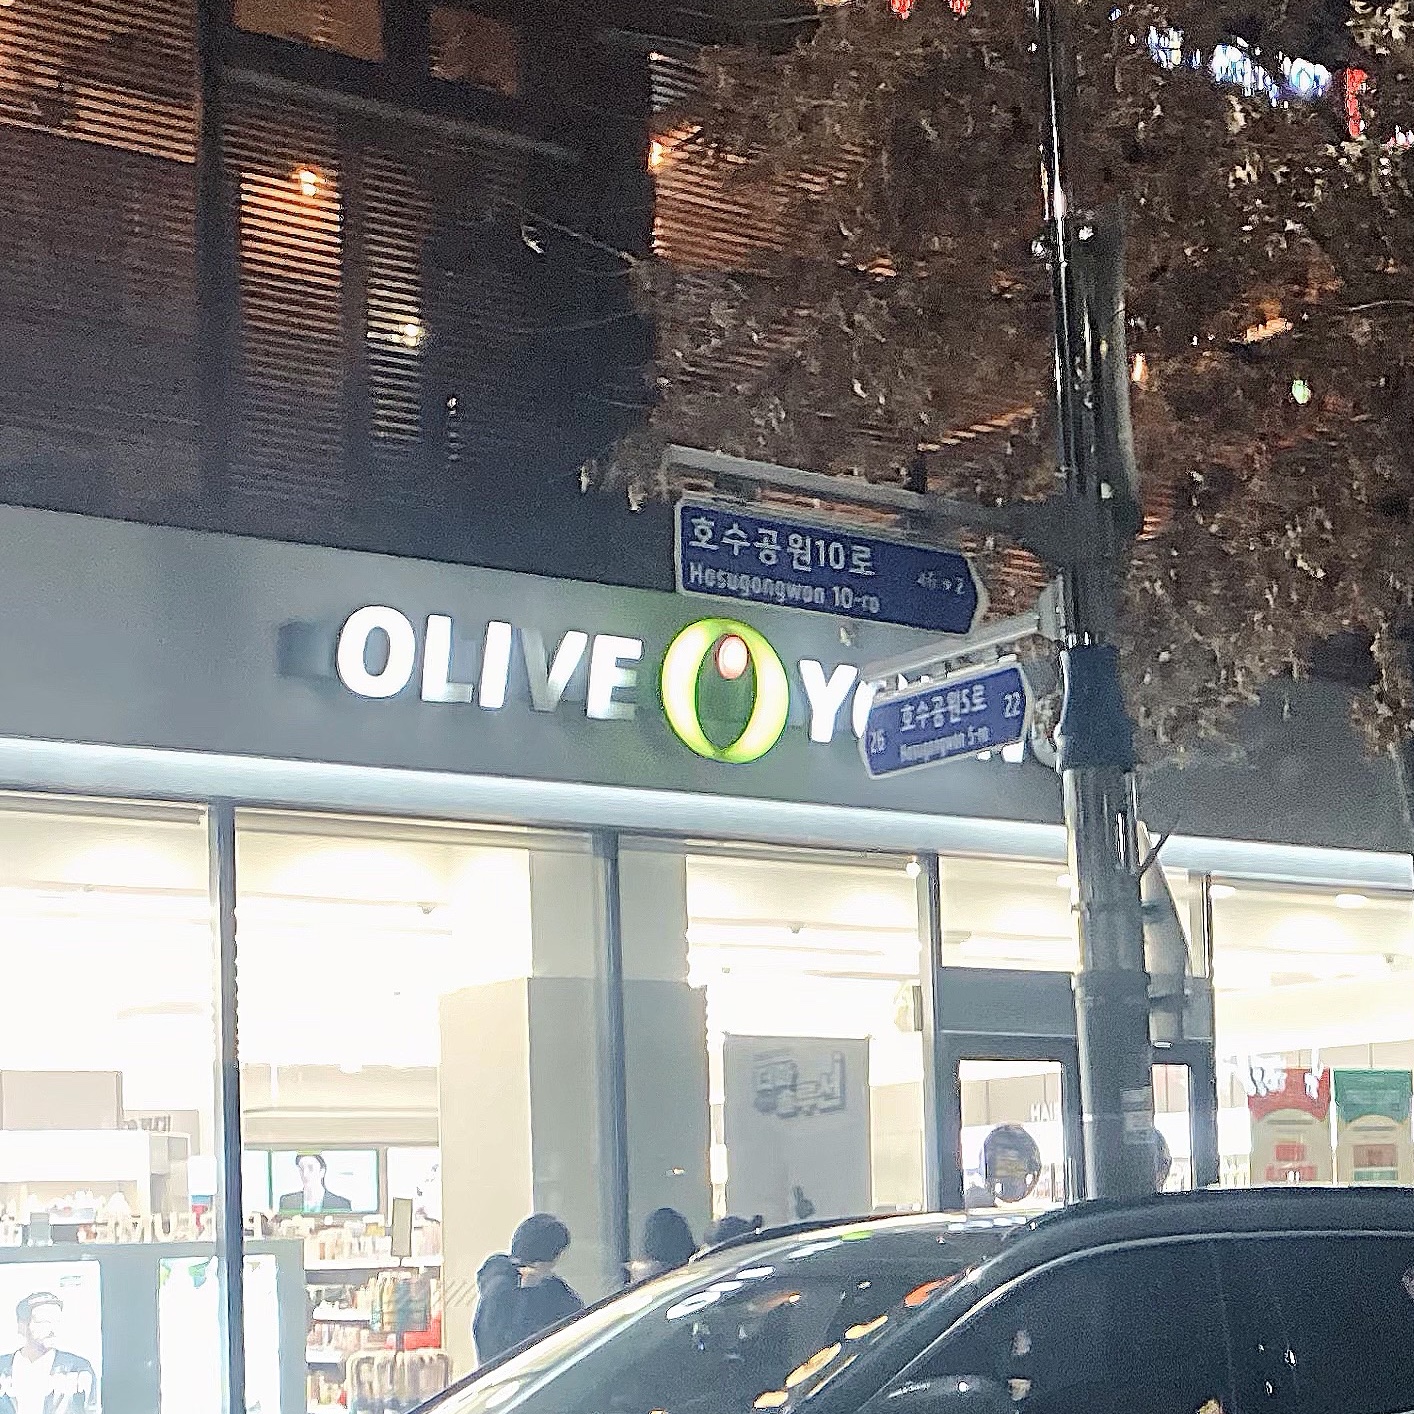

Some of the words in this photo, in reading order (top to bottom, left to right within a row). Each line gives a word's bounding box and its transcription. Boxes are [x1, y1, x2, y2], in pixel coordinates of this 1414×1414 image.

[689, 515, 875, 577] 호수공원10로
[337, 604, 644, 720] OLIVE
[900, 684, 988, 731] 호수공원5로
